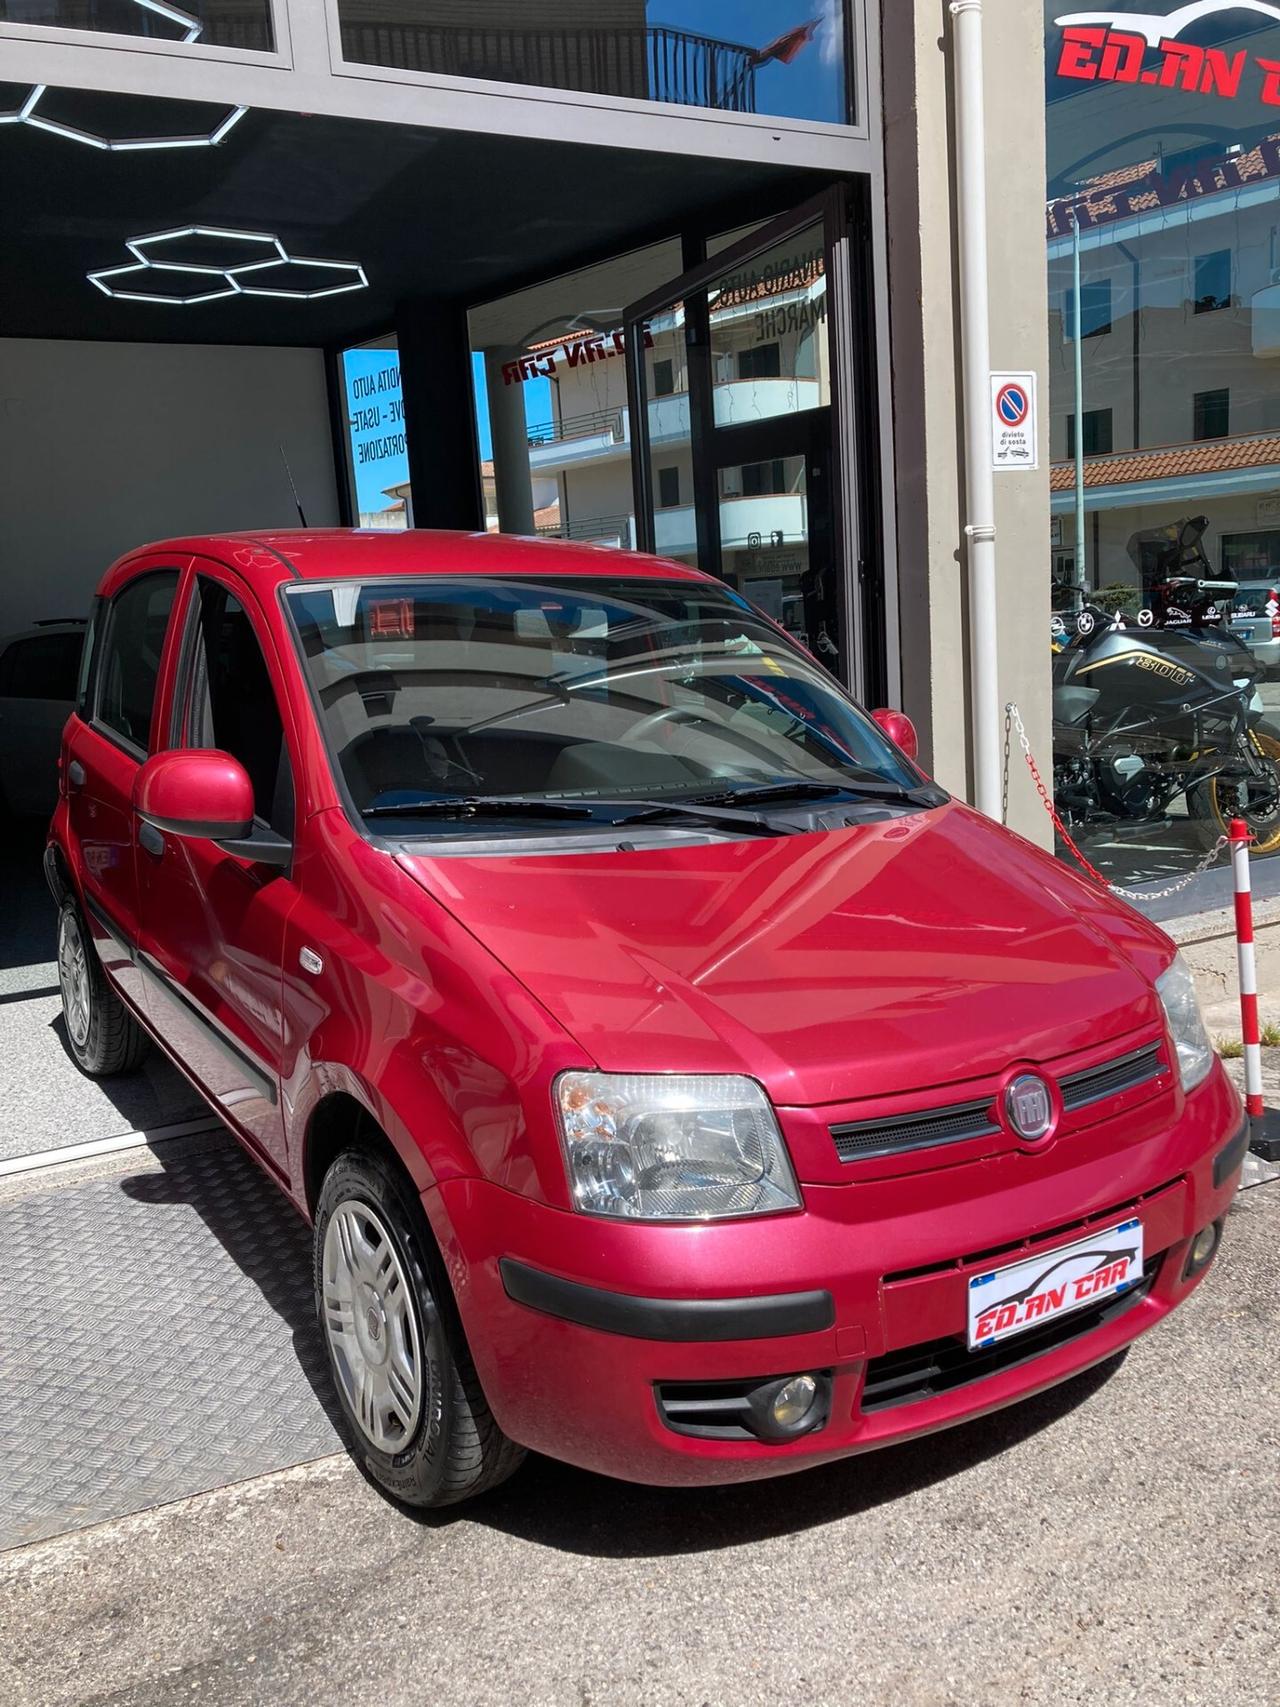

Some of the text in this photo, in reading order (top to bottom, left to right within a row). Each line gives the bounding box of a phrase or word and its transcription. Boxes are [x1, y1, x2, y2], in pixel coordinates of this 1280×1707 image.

[1057, 27, 1247, 98] ED.AN
[975, 1257, 1130, 1341] ED.AN CAR
